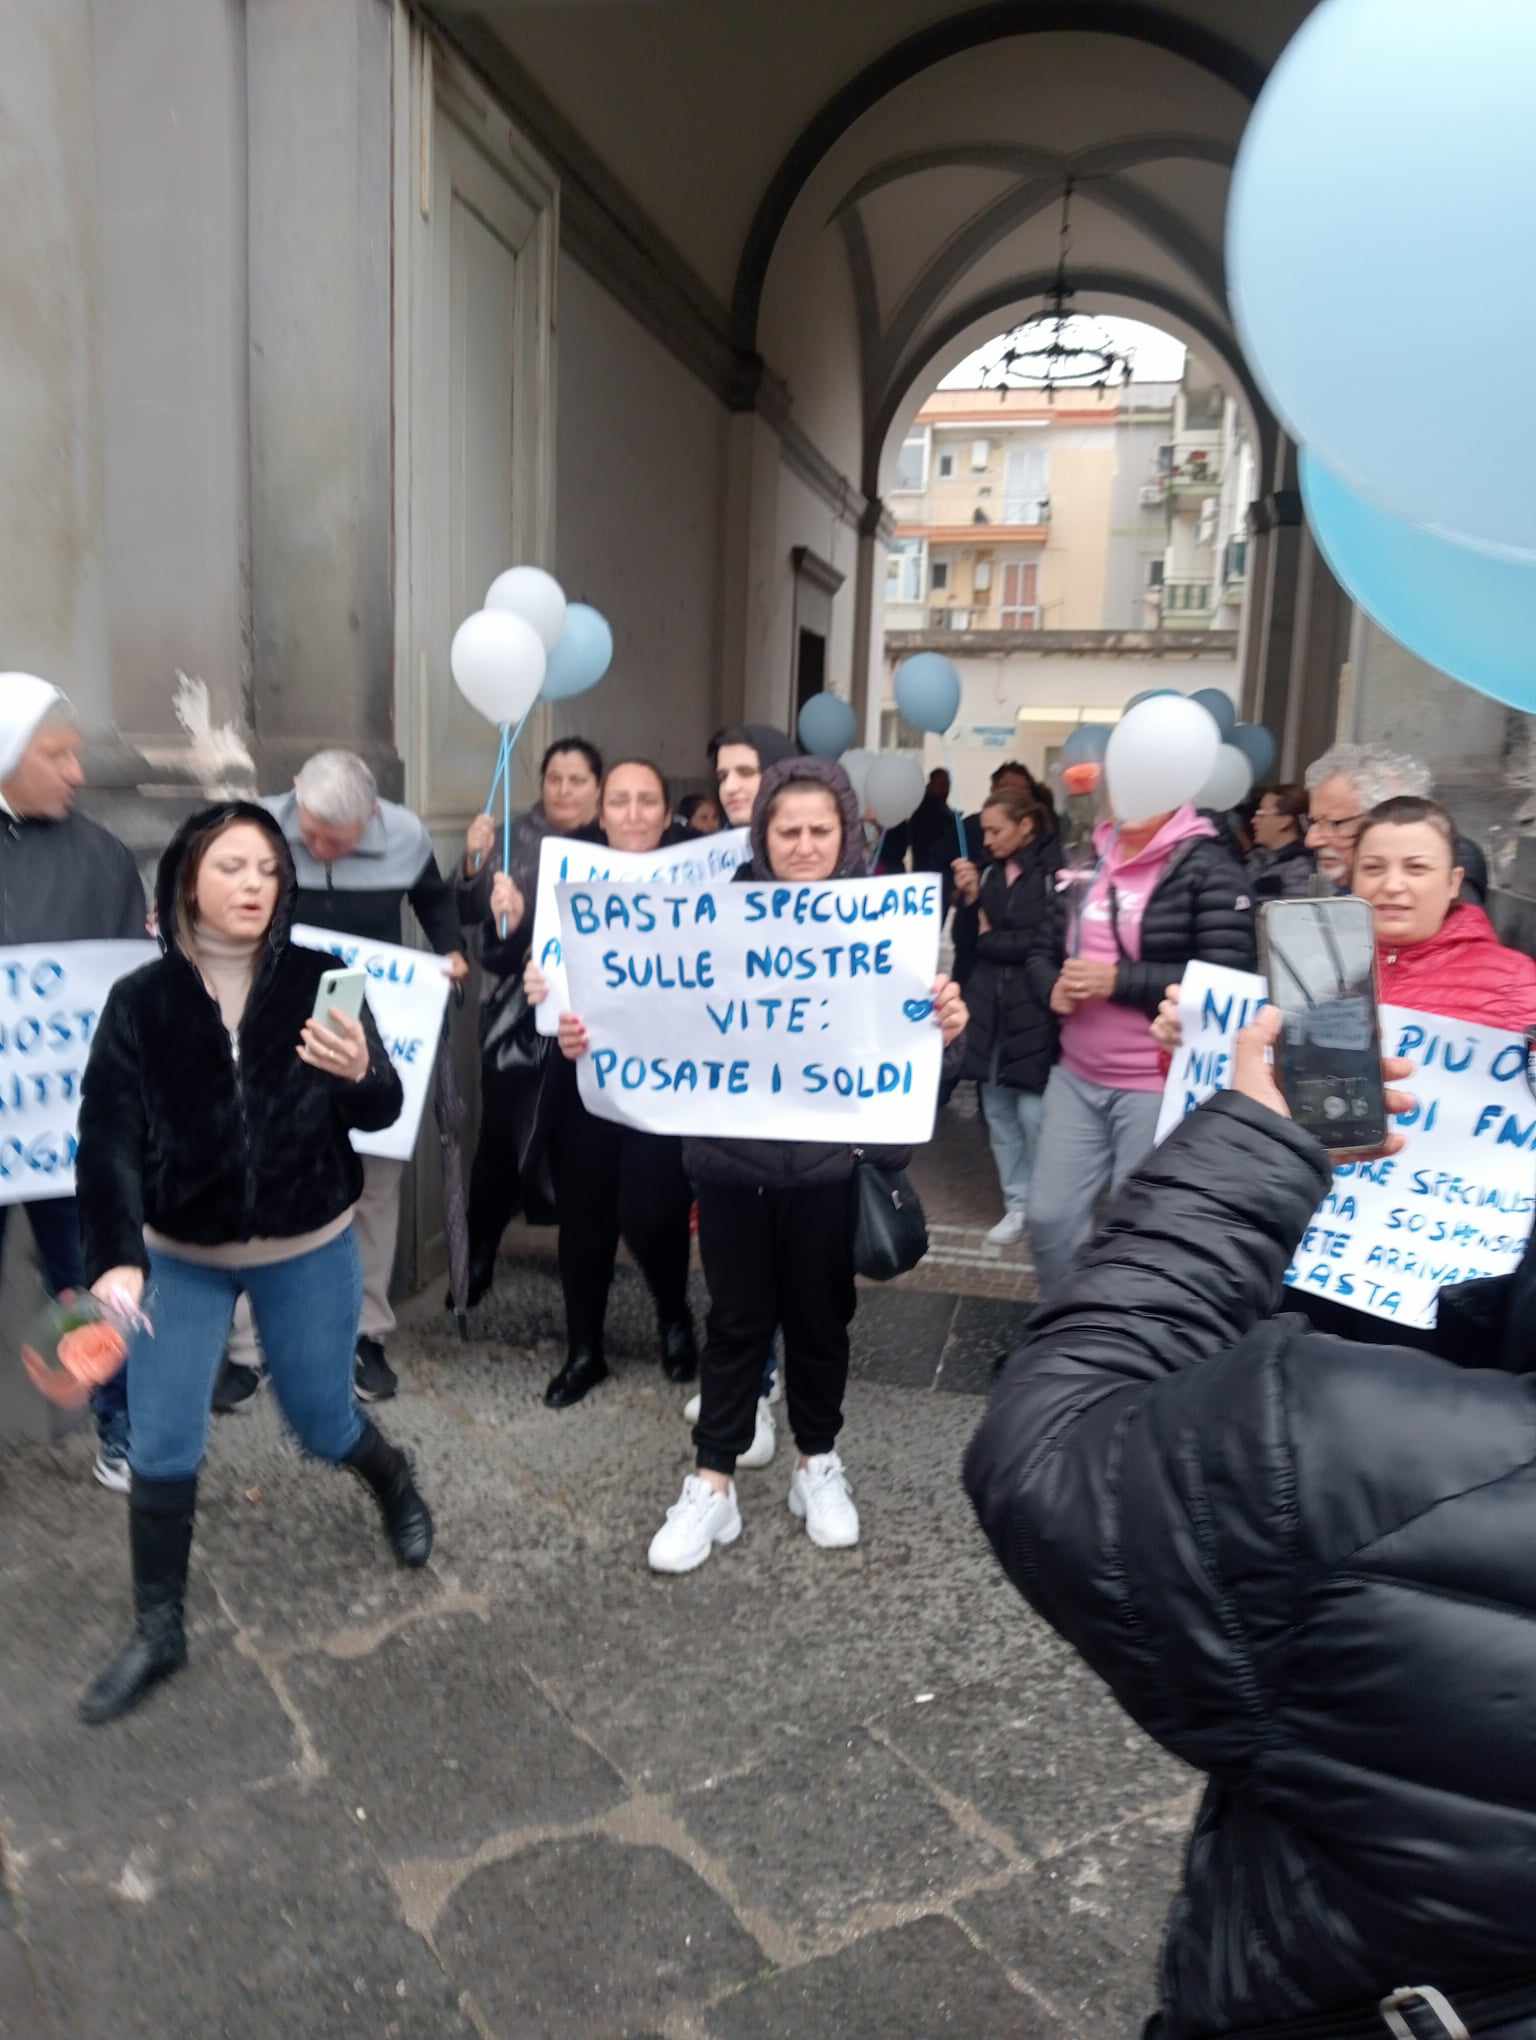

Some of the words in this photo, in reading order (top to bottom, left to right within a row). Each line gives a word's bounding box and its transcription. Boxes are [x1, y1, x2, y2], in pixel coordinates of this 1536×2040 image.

[570, 892, 717, 934] BASTA
[743, 885, 937, 923] SPECULARE
[602, 950, 715, 988] SULLE
[746, 939, 893, 979] NOSTRE
[591, 1049, 750, 1094] POSATE
[772, 1063, 782, 1094] I
[803, 1061, 912, 1098] SOLDI
